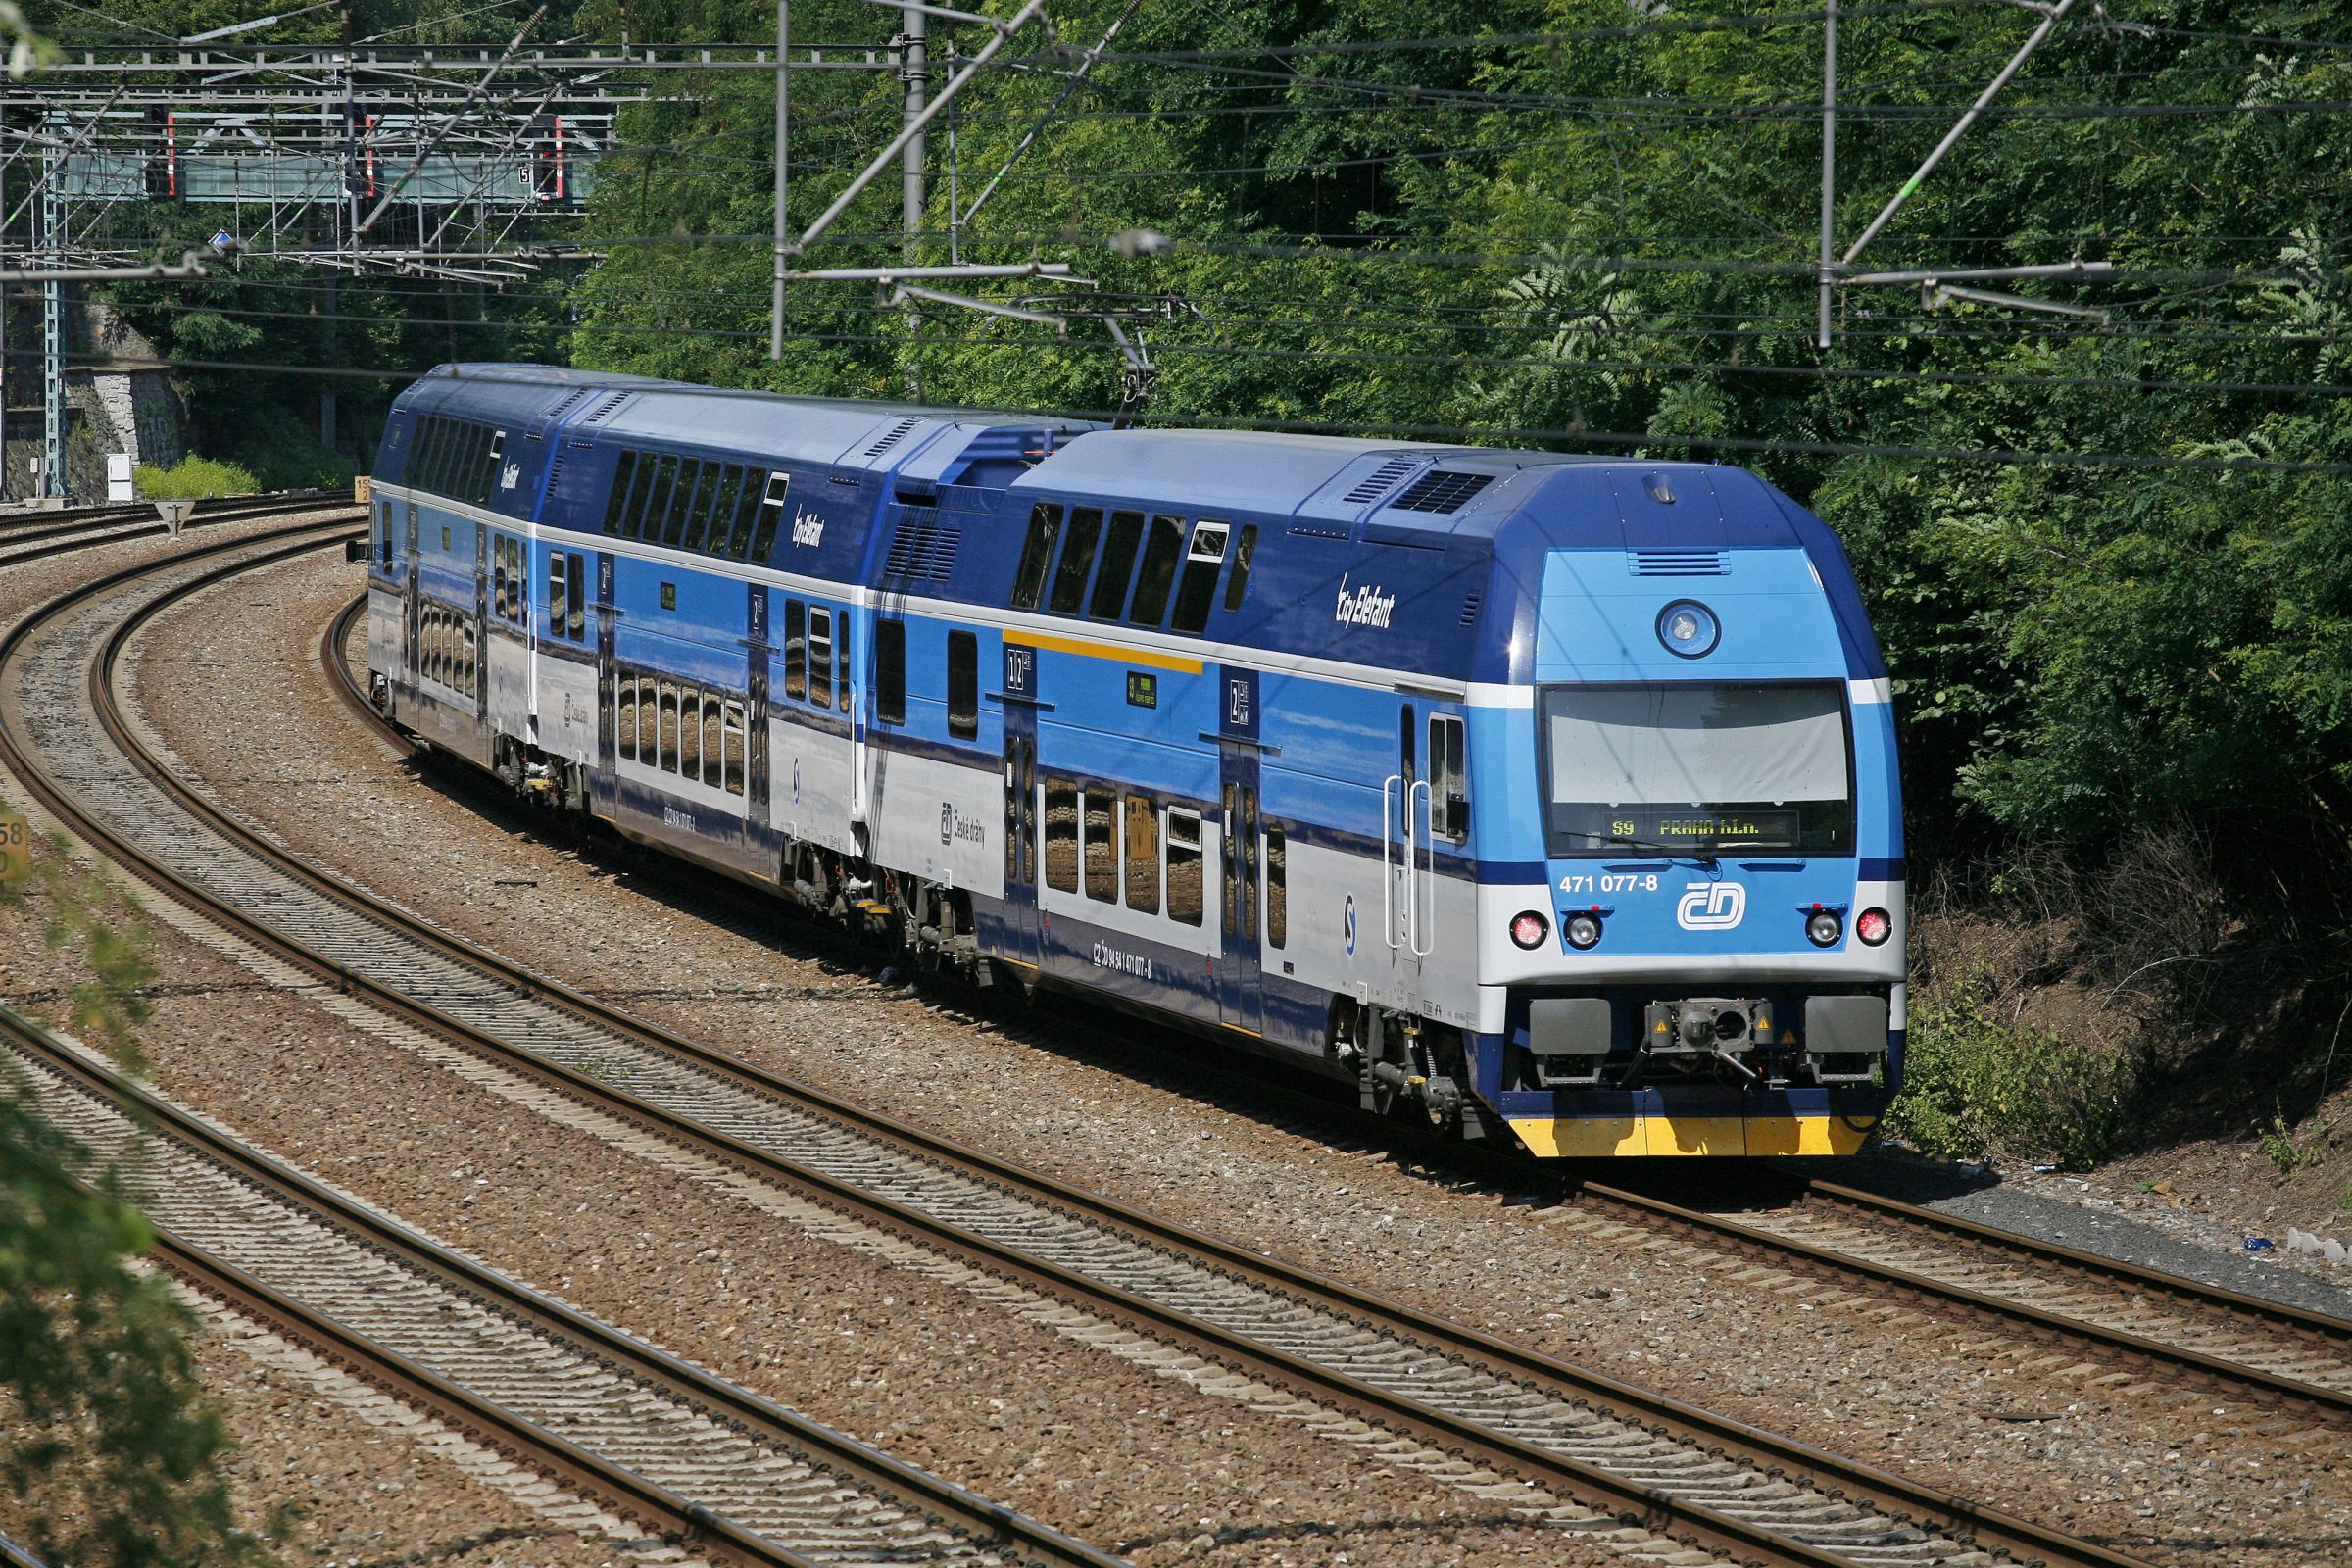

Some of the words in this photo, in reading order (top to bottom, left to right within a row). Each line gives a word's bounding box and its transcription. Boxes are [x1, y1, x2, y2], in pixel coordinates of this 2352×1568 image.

[363, 491, 368, 501] 2
[1612, 820, 1635, 835] S9
[1660, 819, 1714, 835] PRAHA
[1559, 875, 1594, 892] 471
[1600, 874, 1658, 892] 077-8
